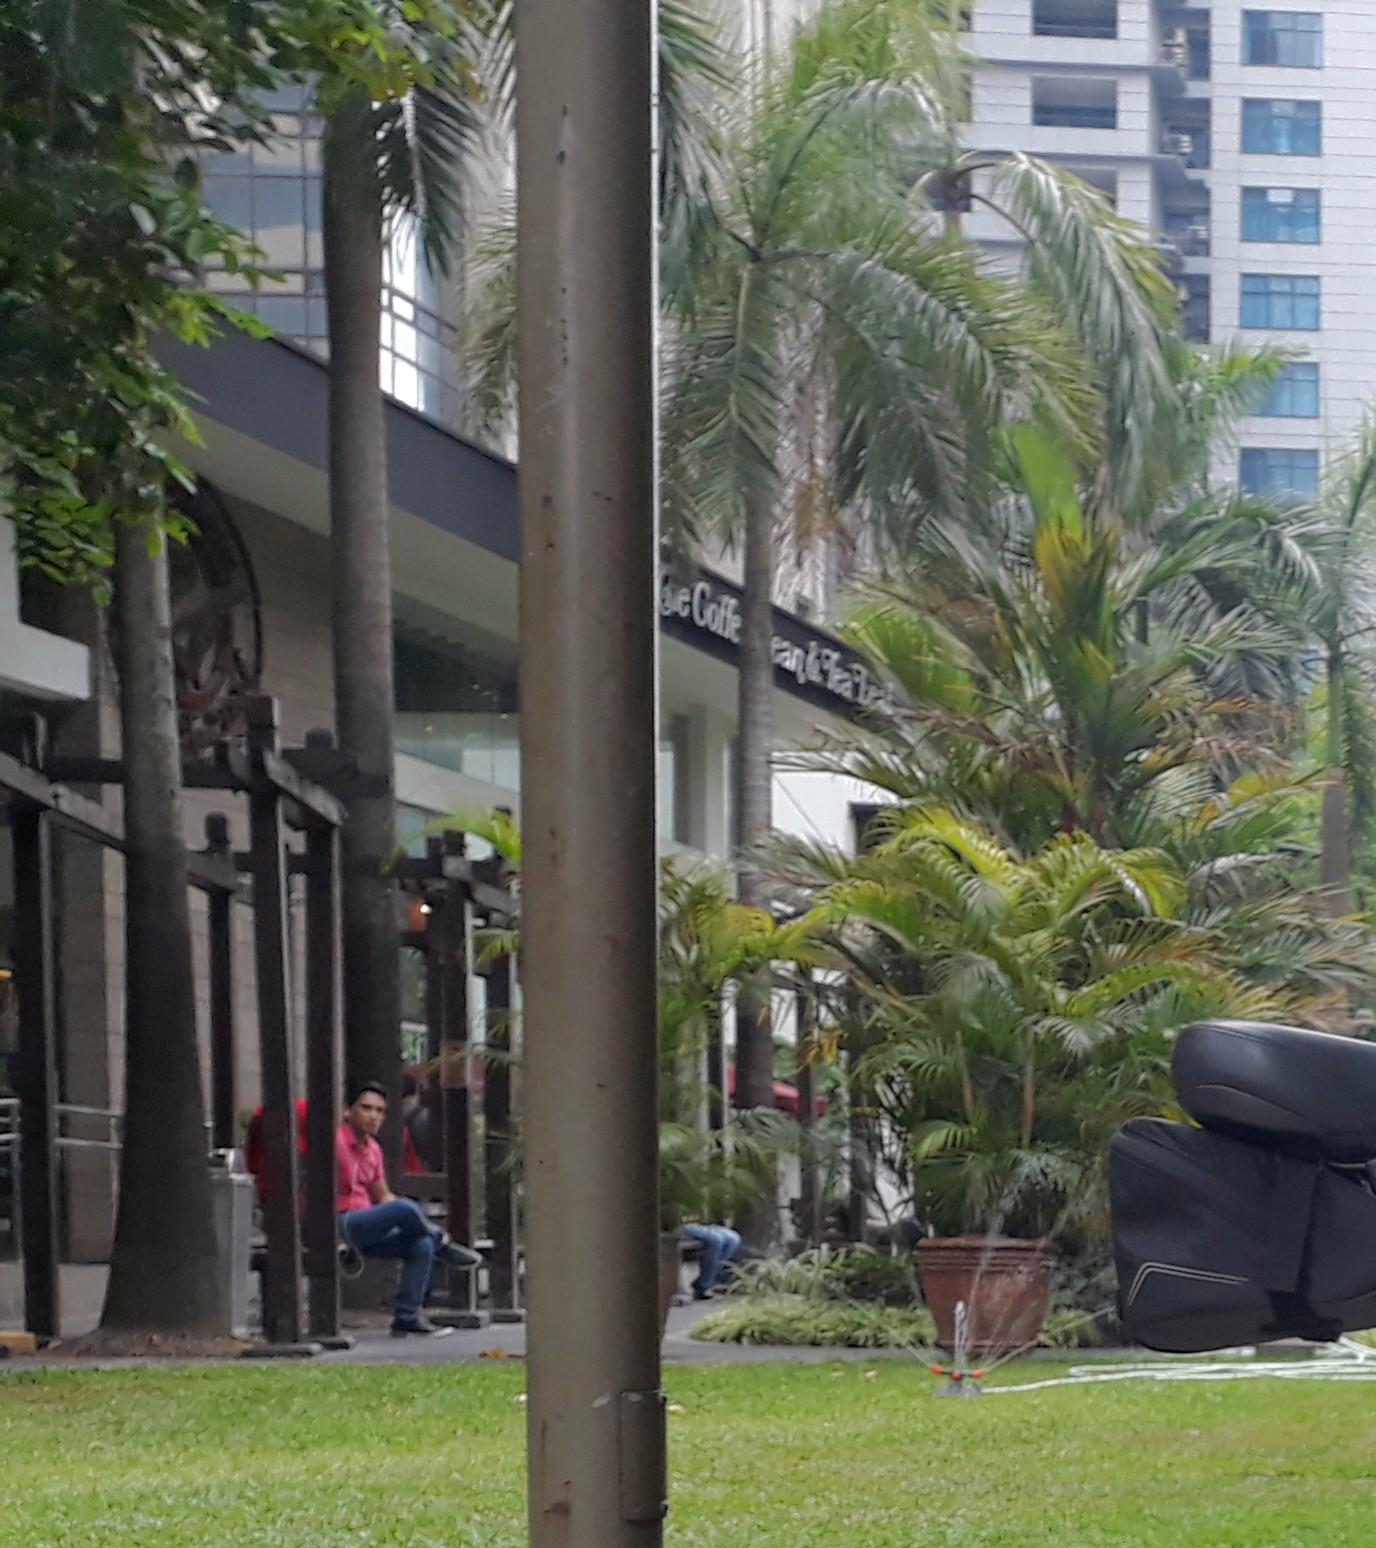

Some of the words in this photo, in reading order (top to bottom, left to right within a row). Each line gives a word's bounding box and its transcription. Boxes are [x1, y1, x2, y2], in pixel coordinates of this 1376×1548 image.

[692, 581, 743, 644] Coffe
[770, 635, 807, 685] ean
[820, 648, 853, 702] Tea
